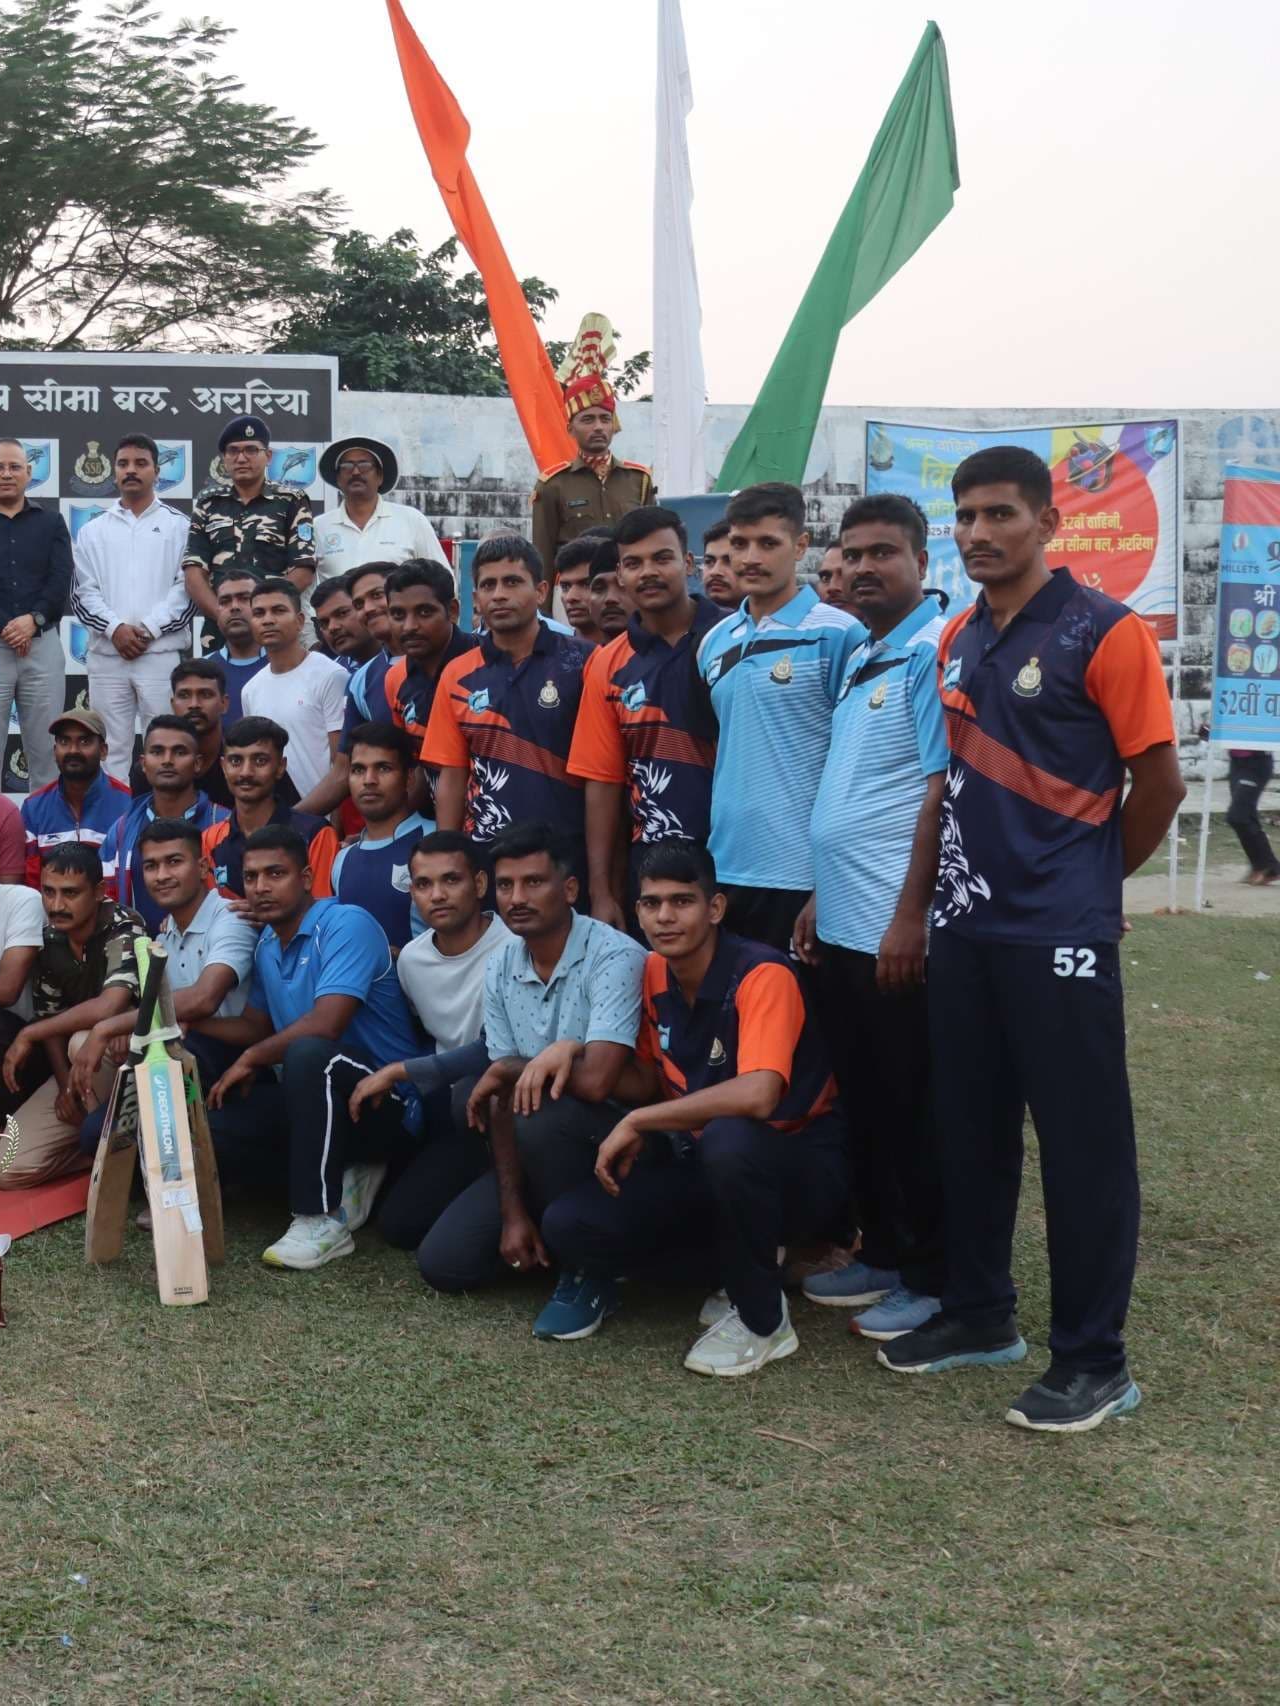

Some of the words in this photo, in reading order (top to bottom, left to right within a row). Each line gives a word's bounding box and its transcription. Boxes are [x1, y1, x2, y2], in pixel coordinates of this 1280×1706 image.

[20, 378, 101, 413] सीमा
[188, 379, 311, 417] अररिया
[1053, 947, 1096, 977] 52
[158, 1090, 174, 1155] DECATHLON
